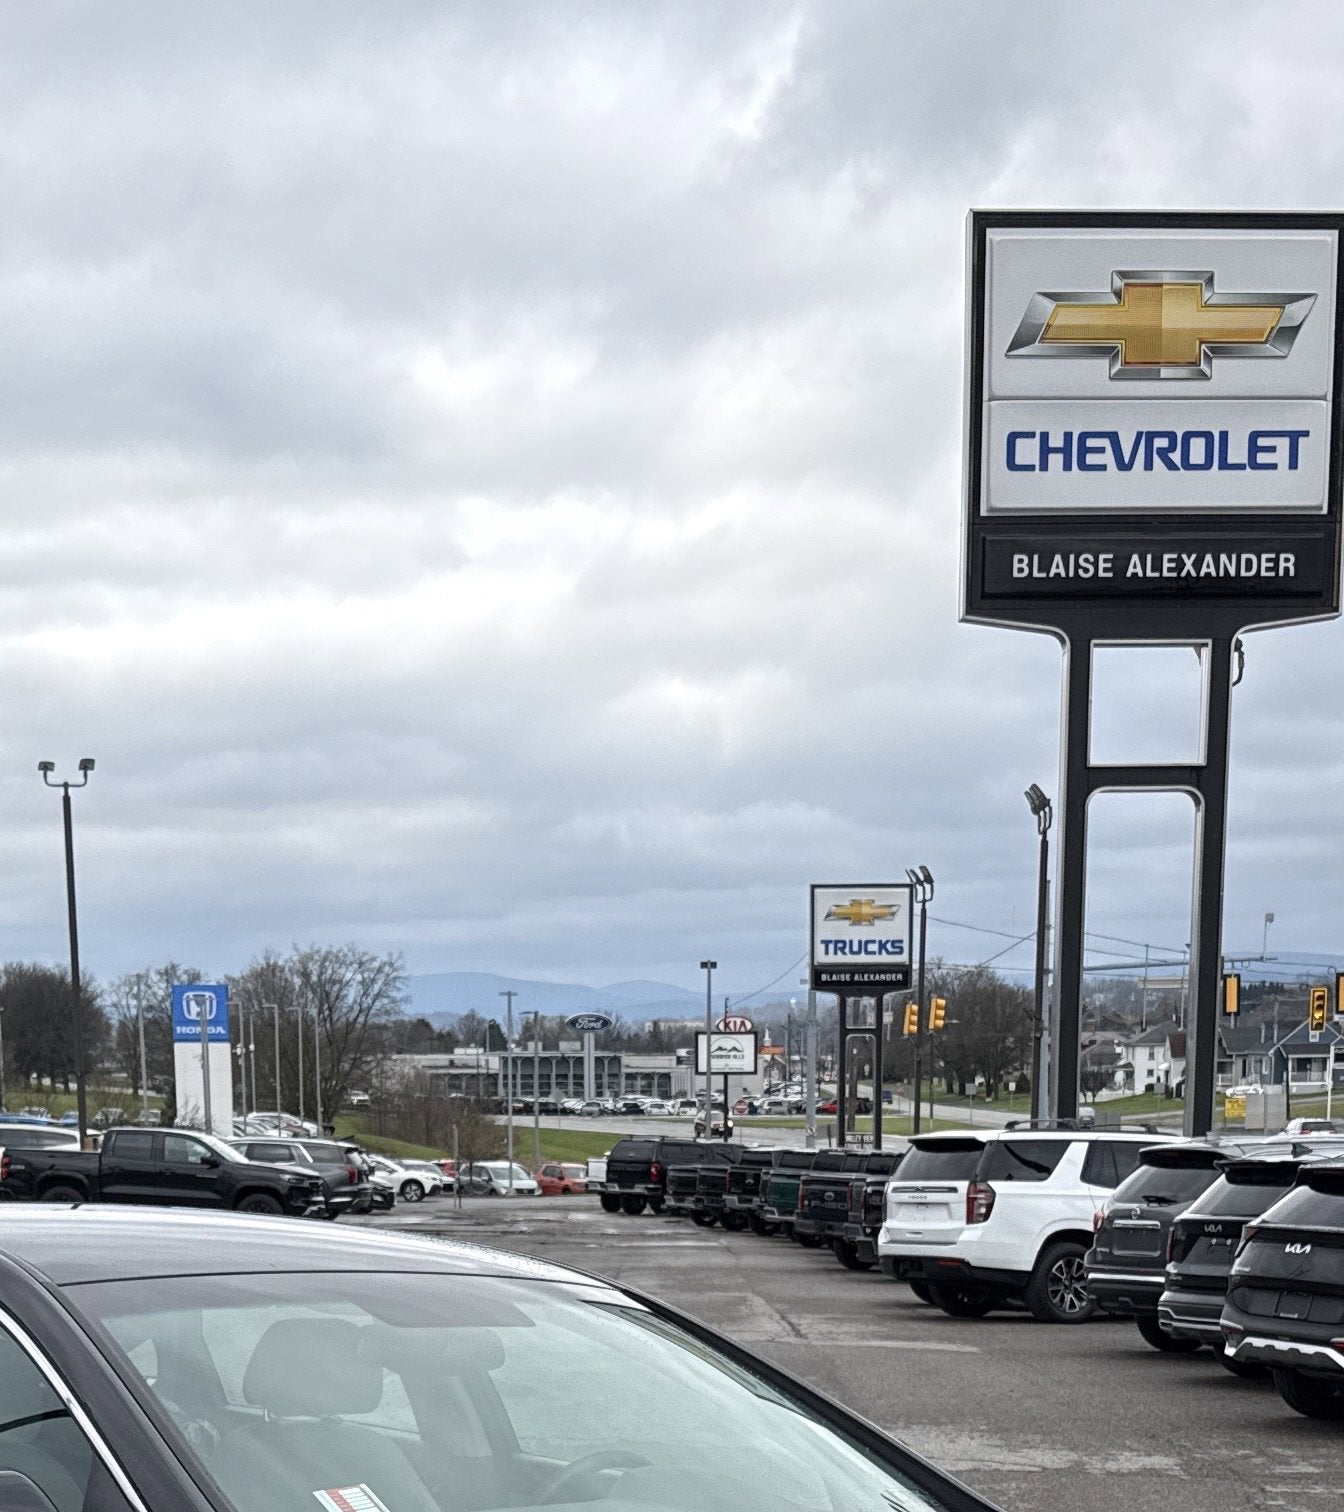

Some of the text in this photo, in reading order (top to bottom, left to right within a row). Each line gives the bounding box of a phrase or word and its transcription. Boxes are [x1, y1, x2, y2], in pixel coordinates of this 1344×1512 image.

[1006, 429, 1311, 473] CHEVROLET
[1011, 552, 1297, 579] BLAISE ALEXANDER
[820, 938, 905, 956] TRUCKS
[820, 973, 903, 982] BLAISE ALEXANDER
[575, 1016, 604, 1030] Ford
[723, 1017, 748, 1031] KIA
